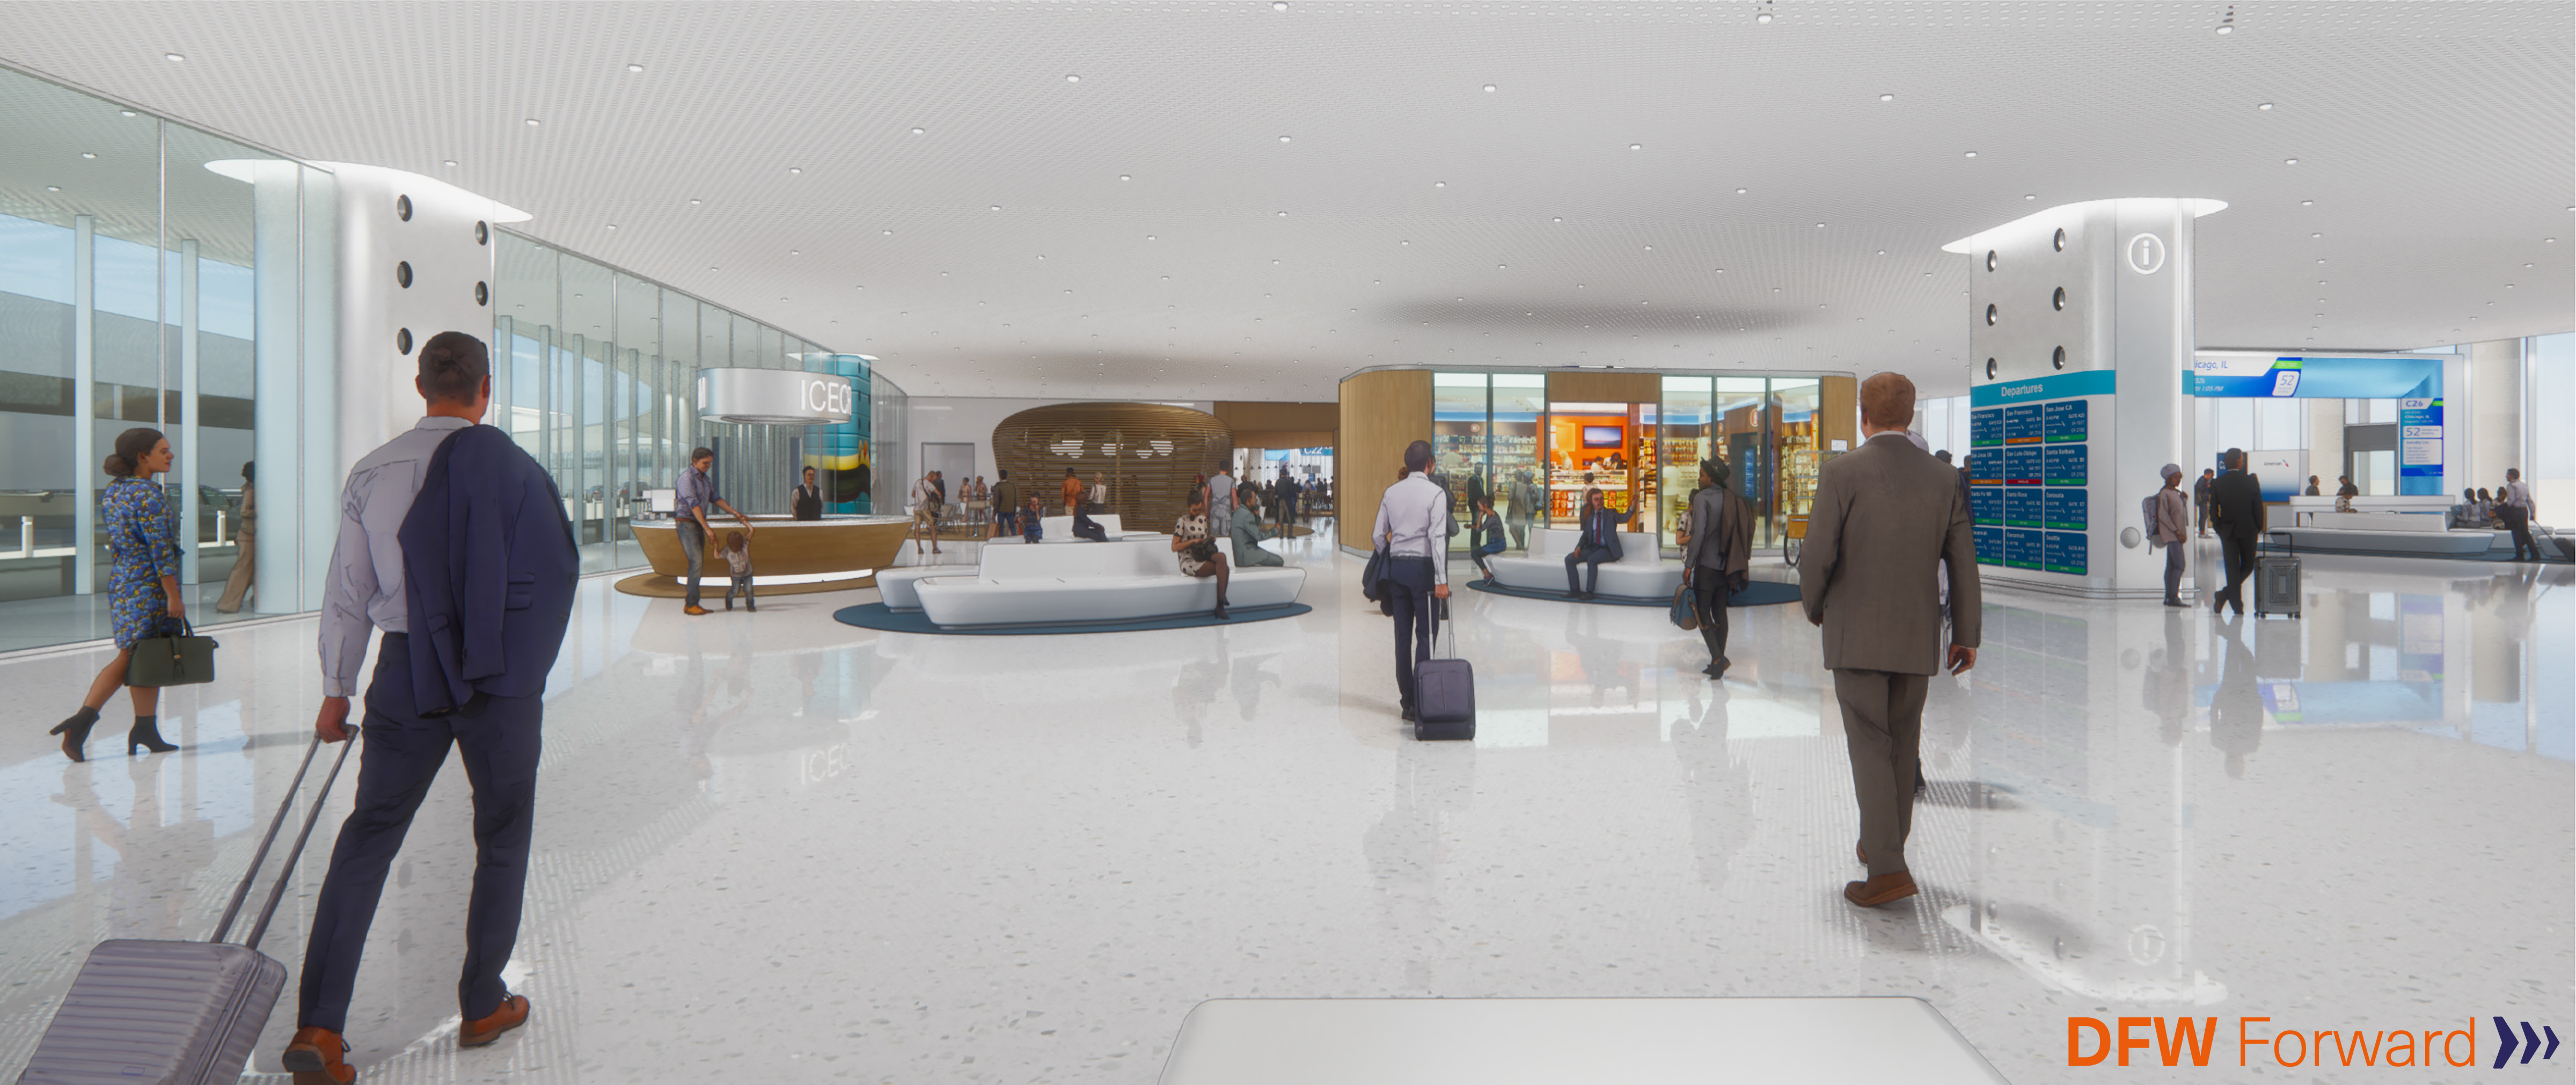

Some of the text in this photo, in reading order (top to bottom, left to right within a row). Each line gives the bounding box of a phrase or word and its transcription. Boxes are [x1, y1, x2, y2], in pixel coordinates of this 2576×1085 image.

[2194, 360, 2228, 370] icago, IL
[2280, 375, 2295, 385] 52
[2001, 384, 2043, 398] Departures
[2406, 427, 2420, 436] 52
[1304, 446, 1323, 454] C22
